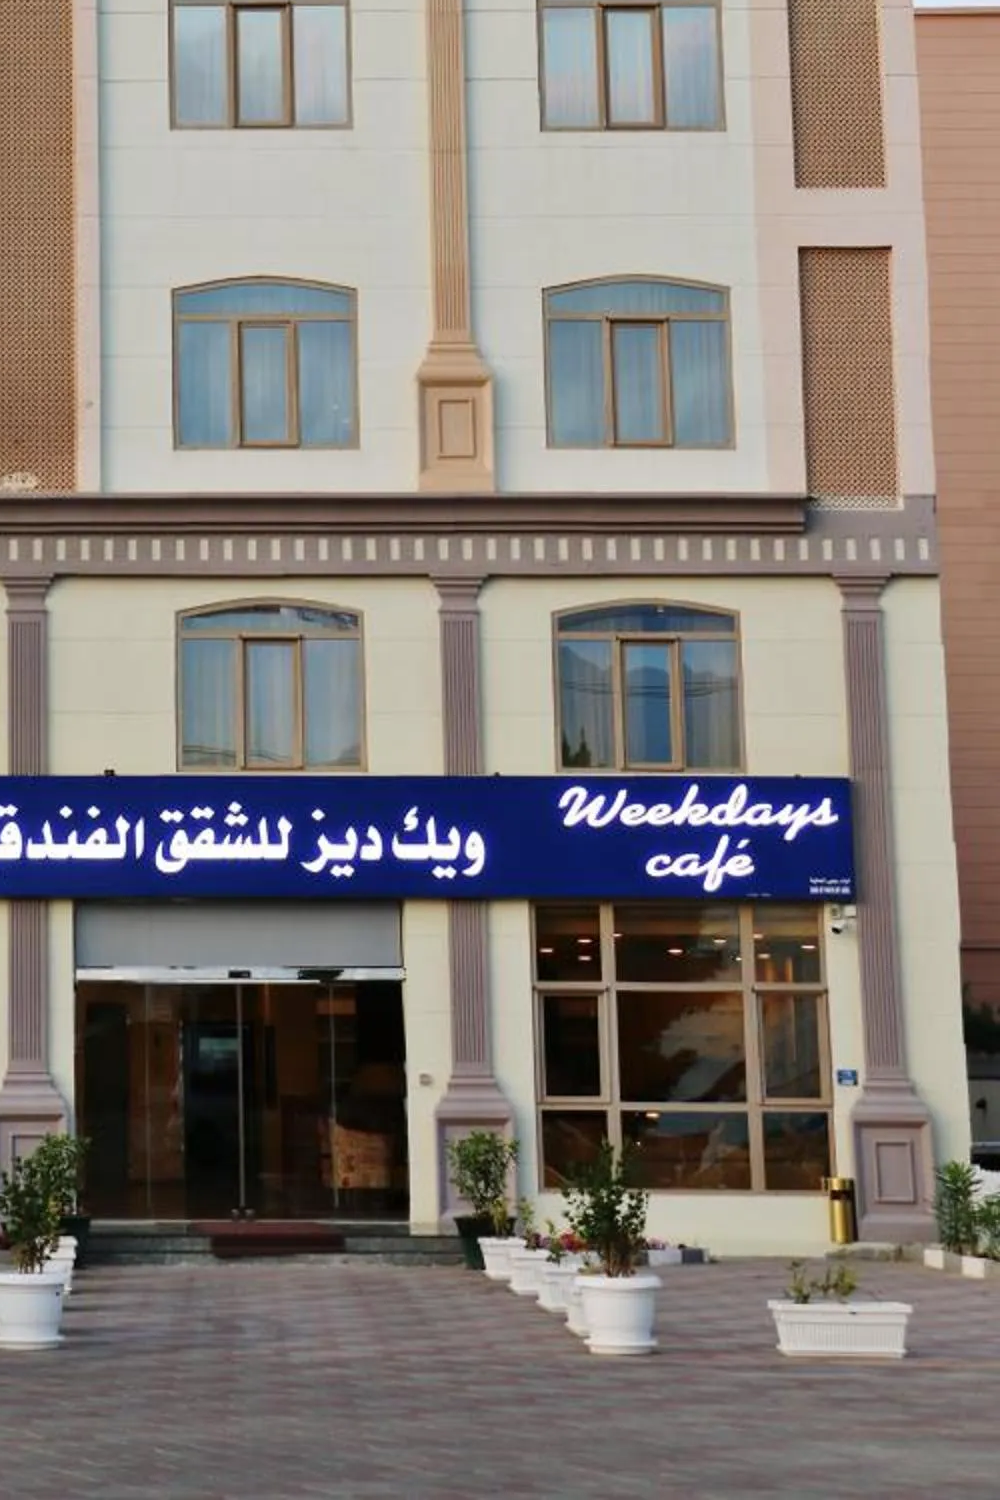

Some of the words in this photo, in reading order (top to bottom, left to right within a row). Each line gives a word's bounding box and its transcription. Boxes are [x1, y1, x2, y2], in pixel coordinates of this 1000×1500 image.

[155, 801, 293, 873] للشقق
[301, 808, 383, 878] ديز
[391, 806, 486, 879] ويك
[558, 784, 839, 841] Weekdays
[645, 834, 755, 892] café
